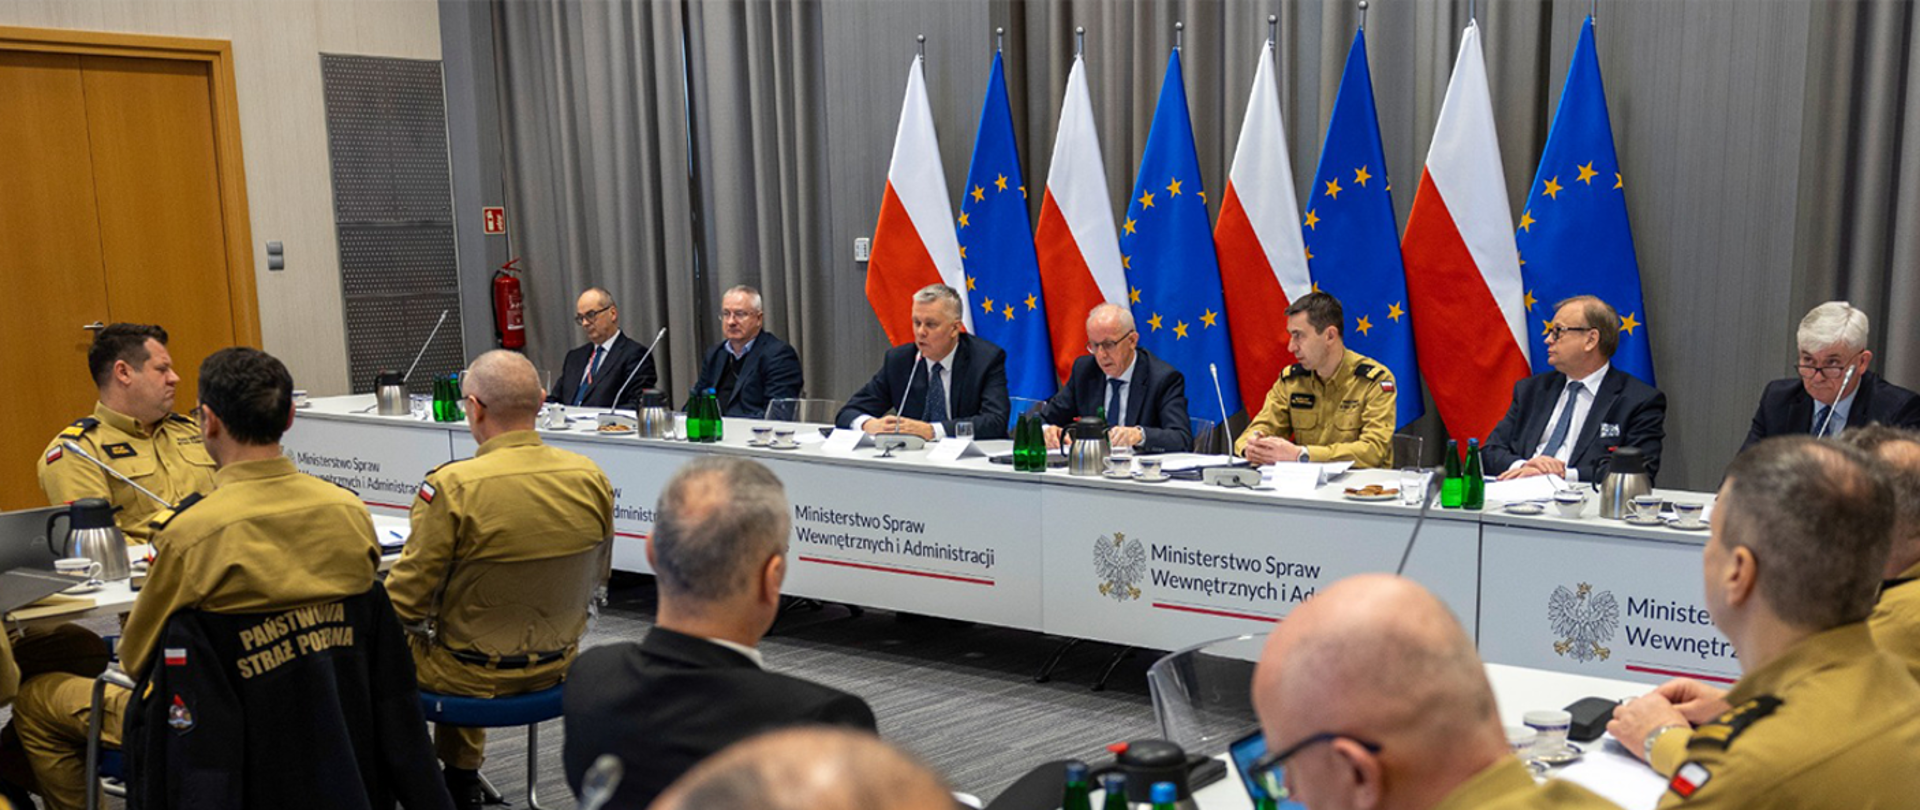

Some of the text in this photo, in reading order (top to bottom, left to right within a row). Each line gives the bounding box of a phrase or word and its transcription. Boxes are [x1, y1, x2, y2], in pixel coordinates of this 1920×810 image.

[297, 451, 380, 473] Ministerstwo Spraw
[795, 505, 925, 534] Ministerstwo Spraw
[796, 526, 995, 568] Wewnętrznych i Administracji
[1151, 543, 1321, 579] Ministerstwo Spraw
[1151, 568, 1277, 602] Wewnętrznych
[1281, 583, 1286, 601] i
[1627, 596, 1715, 626] Ministe
[236, 639, 296, 679] STRAŻ
